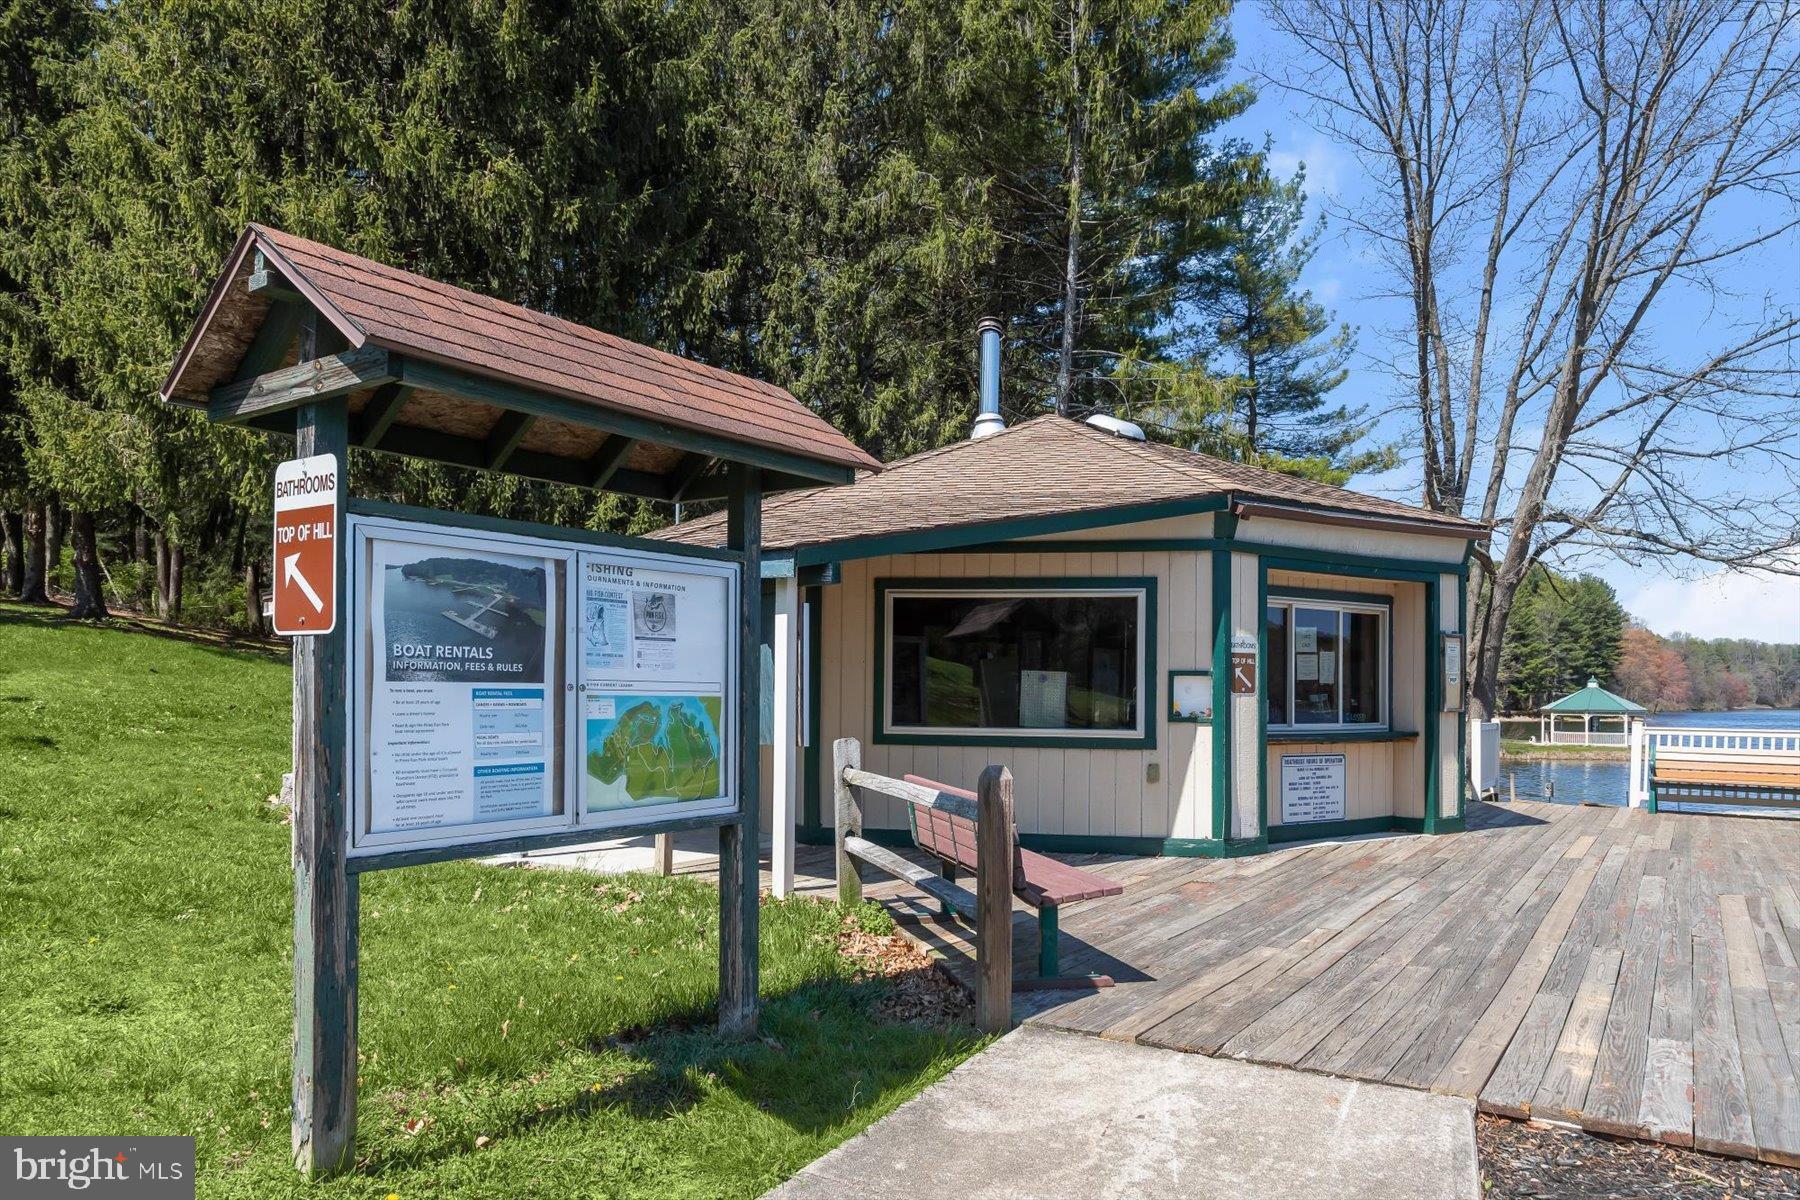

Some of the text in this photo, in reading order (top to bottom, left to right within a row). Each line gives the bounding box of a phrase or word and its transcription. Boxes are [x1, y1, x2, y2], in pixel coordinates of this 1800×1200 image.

[276, 472, 335, 498] BATHROOMS
[278, 522, 332, 544] TOP OF HILL
[587, 575, 634, 587] OURNAMENTS
[642, 581, 686, 592] INFORMATION
[605, 590, 624, 599] CONTEST
[394, 644, 493, 659] BOAT RENTALS
[392, 660, 523, 672] INFORMATION, FEES & RULES
